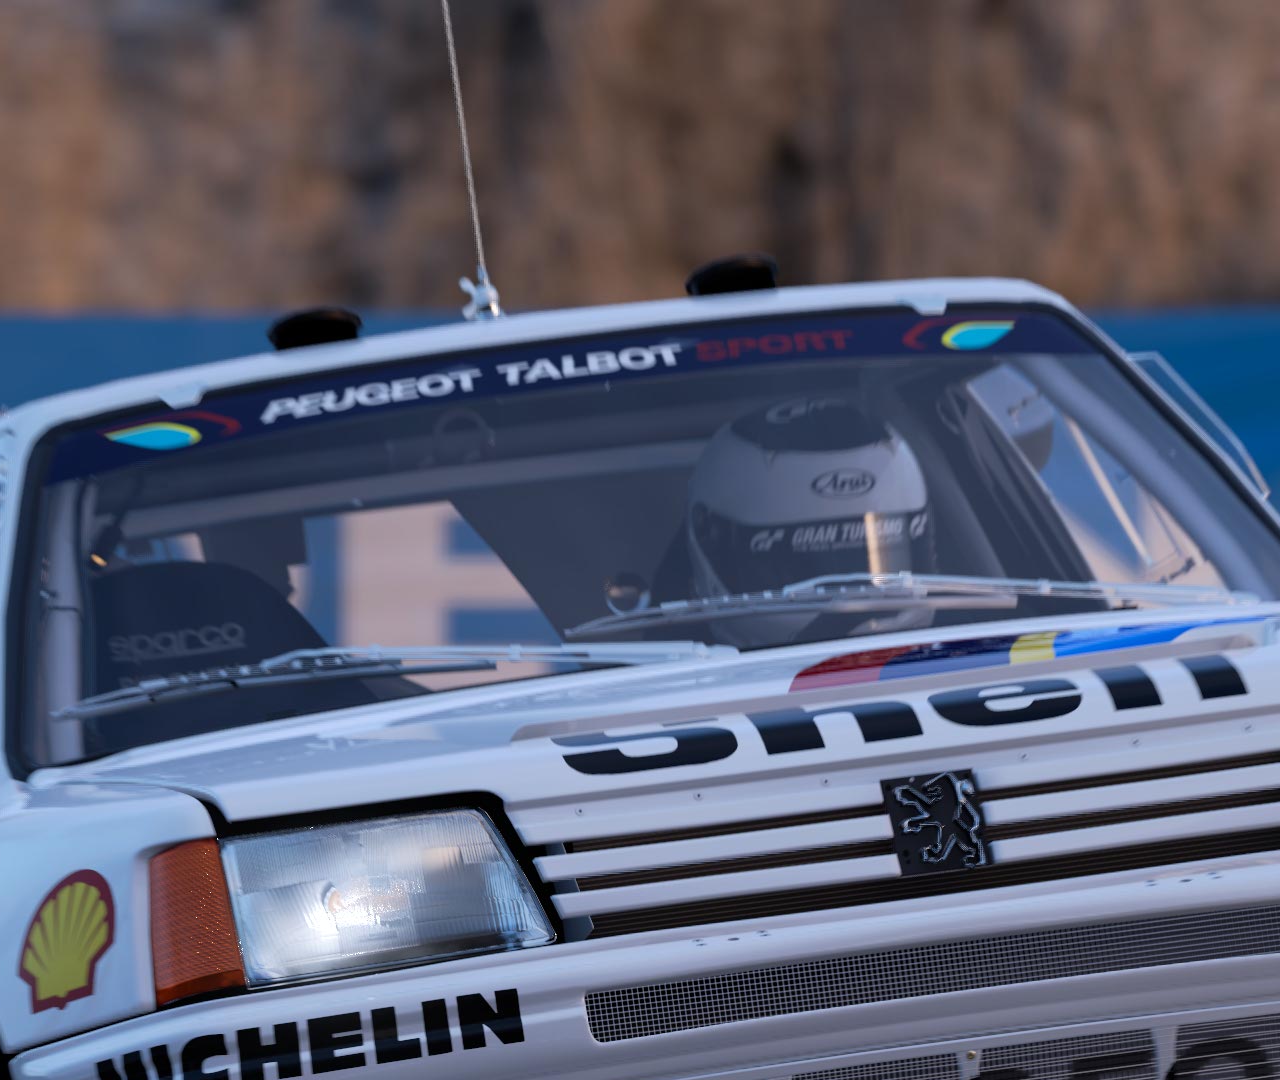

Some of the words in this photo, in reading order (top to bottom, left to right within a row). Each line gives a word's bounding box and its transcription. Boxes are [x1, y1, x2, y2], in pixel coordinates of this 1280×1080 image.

[260, 366, 482, 424] PEUGEOT
[496, 343, 683, 388] TALBOT
[696, 329, 853, 363] SPORT
[792, 525, 837, 546] GRAN
[841, 518, 903, 541] TURSMO
[108, 622, 246, 663] sparco
